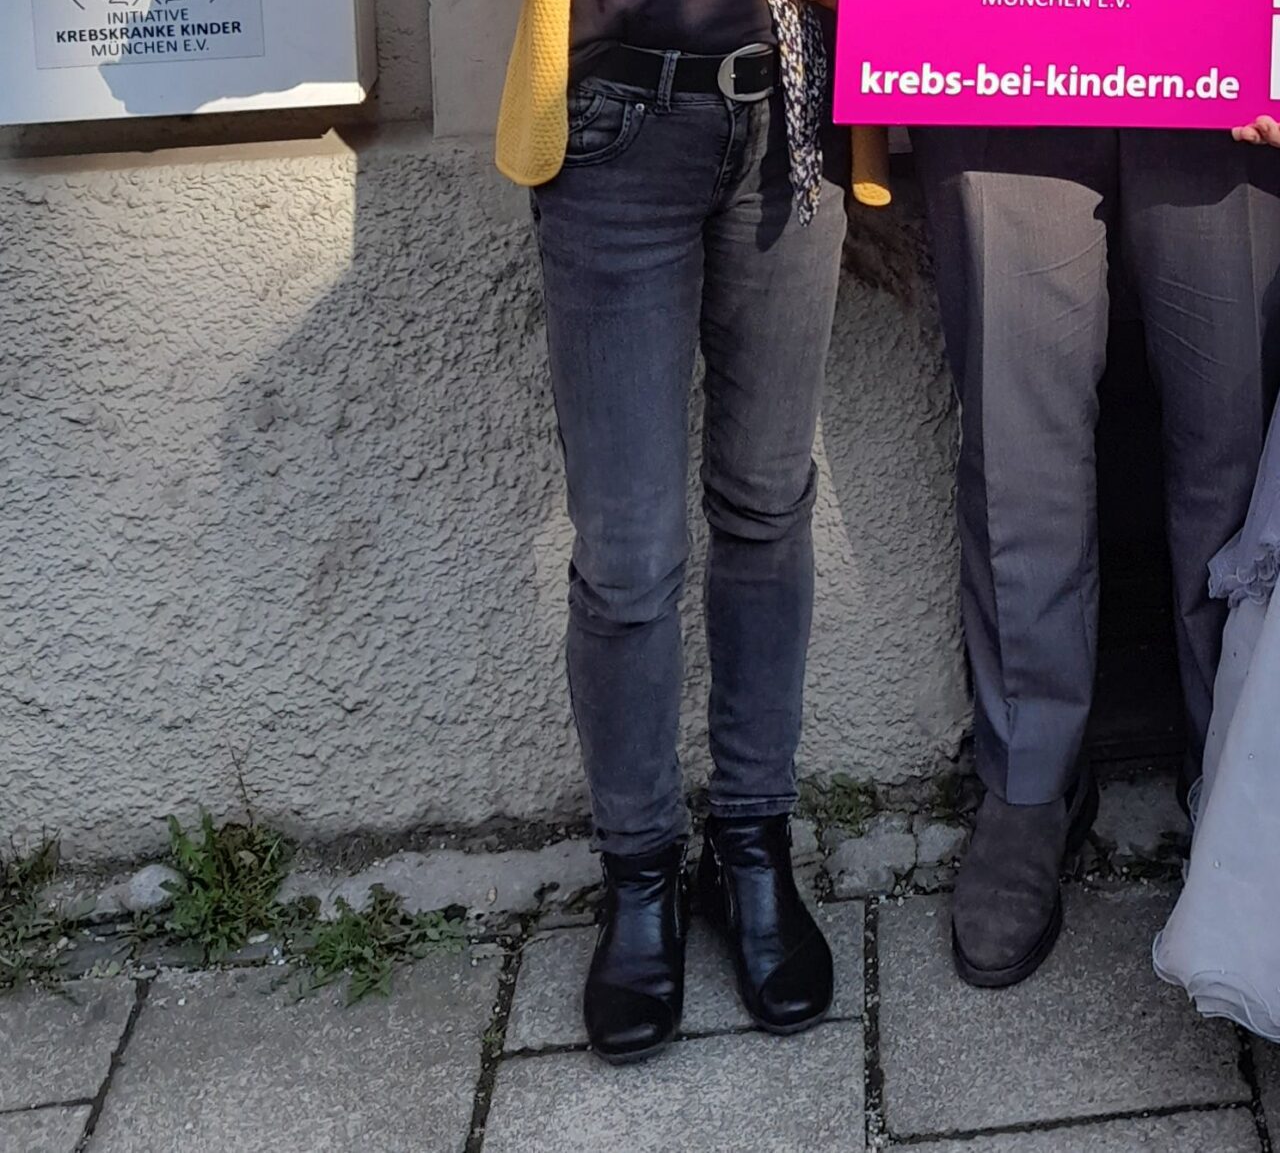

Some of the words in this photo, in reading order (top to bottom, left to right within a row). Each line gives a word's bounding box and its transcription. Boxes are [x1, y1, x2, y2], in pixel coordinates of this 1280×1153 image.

[107, 7, 189, 25] INITIATIVE
[56, 23, 175, 43] KREBSKRANKE
[180, 20, 242, 36] KINDER
[91, 39, 178, 57] MÜNCHEN
[183, 38, 210, 52] E.V.
[860, 62, 1240, 101] krebs-bei-kindern.de
